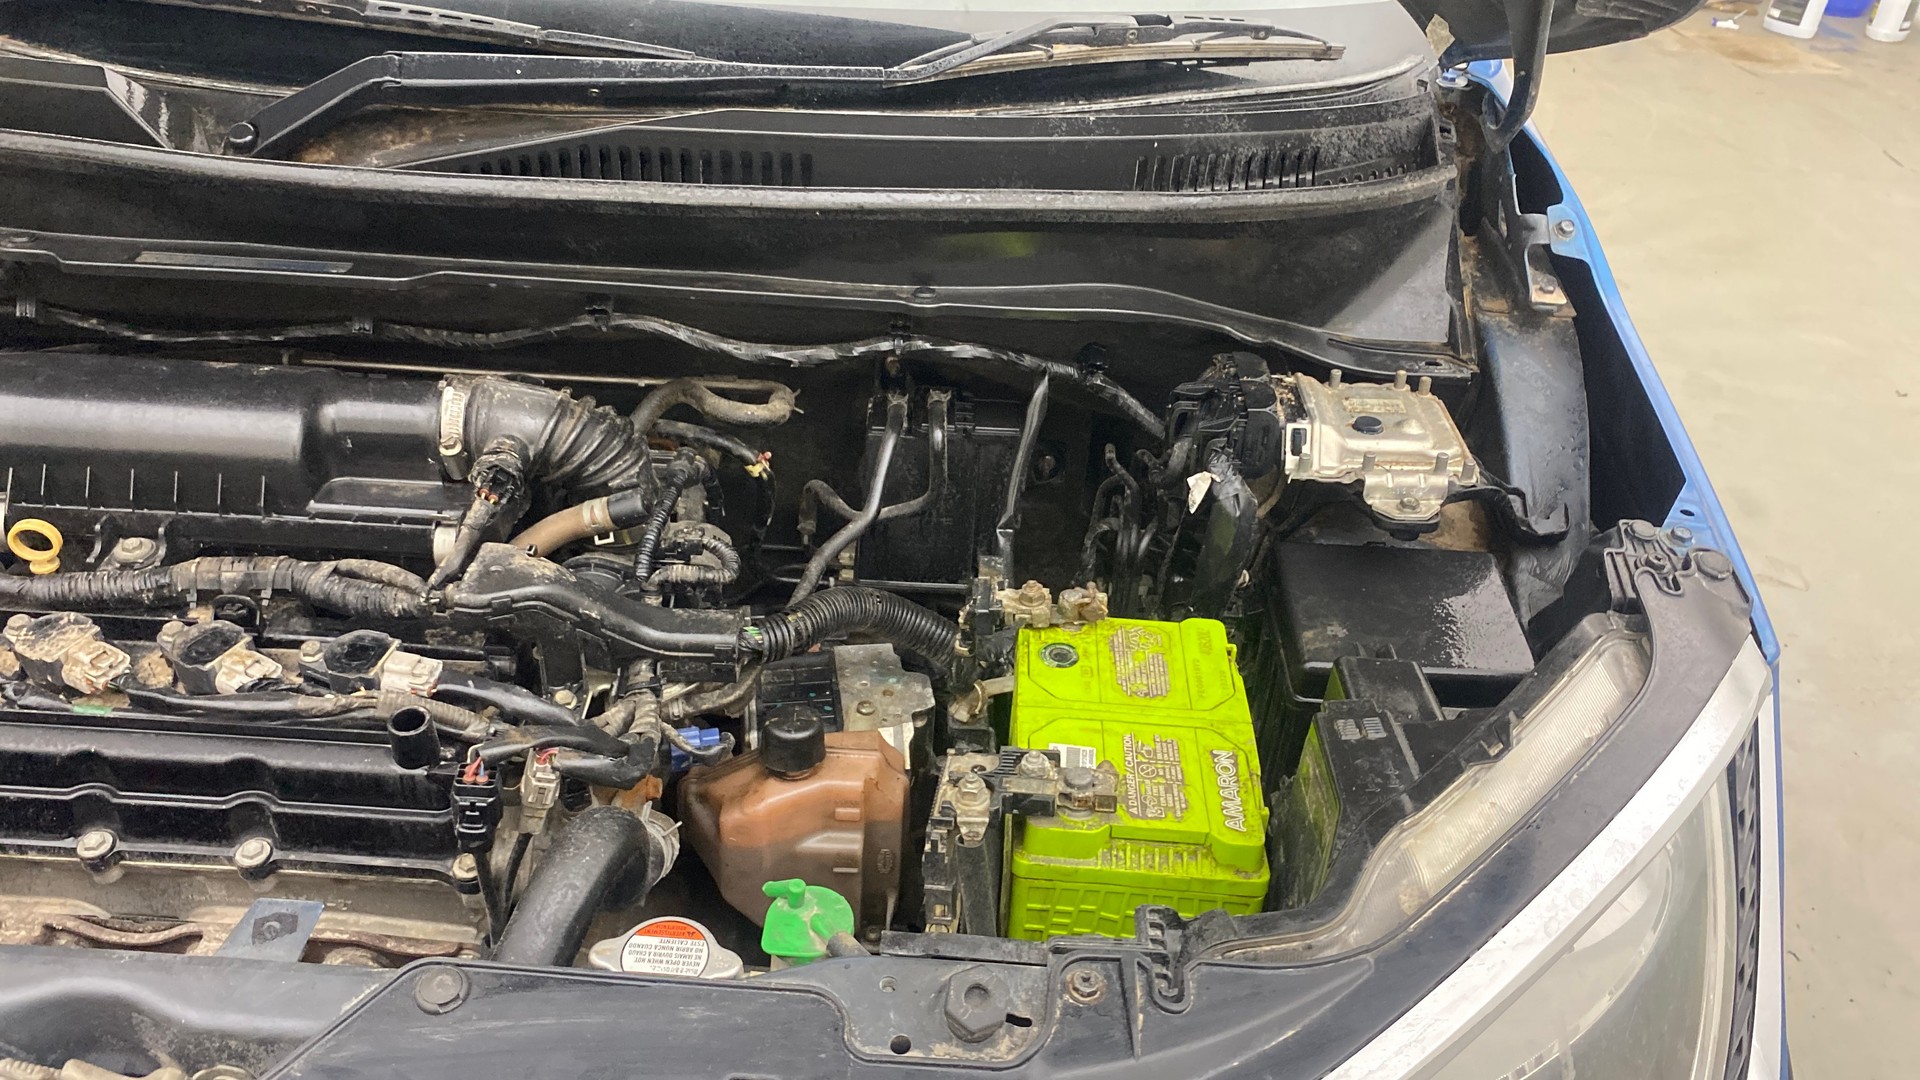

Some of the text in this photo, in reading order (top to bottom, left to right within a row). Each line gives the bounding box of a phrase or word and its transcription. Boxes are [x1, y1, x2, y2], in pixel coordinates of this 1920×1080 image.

[1123, 734, 1134, 767] CAUTION
[1126, 772, 1138, 806] DANGER
[1212, 750, 1247, 832] AMARON
